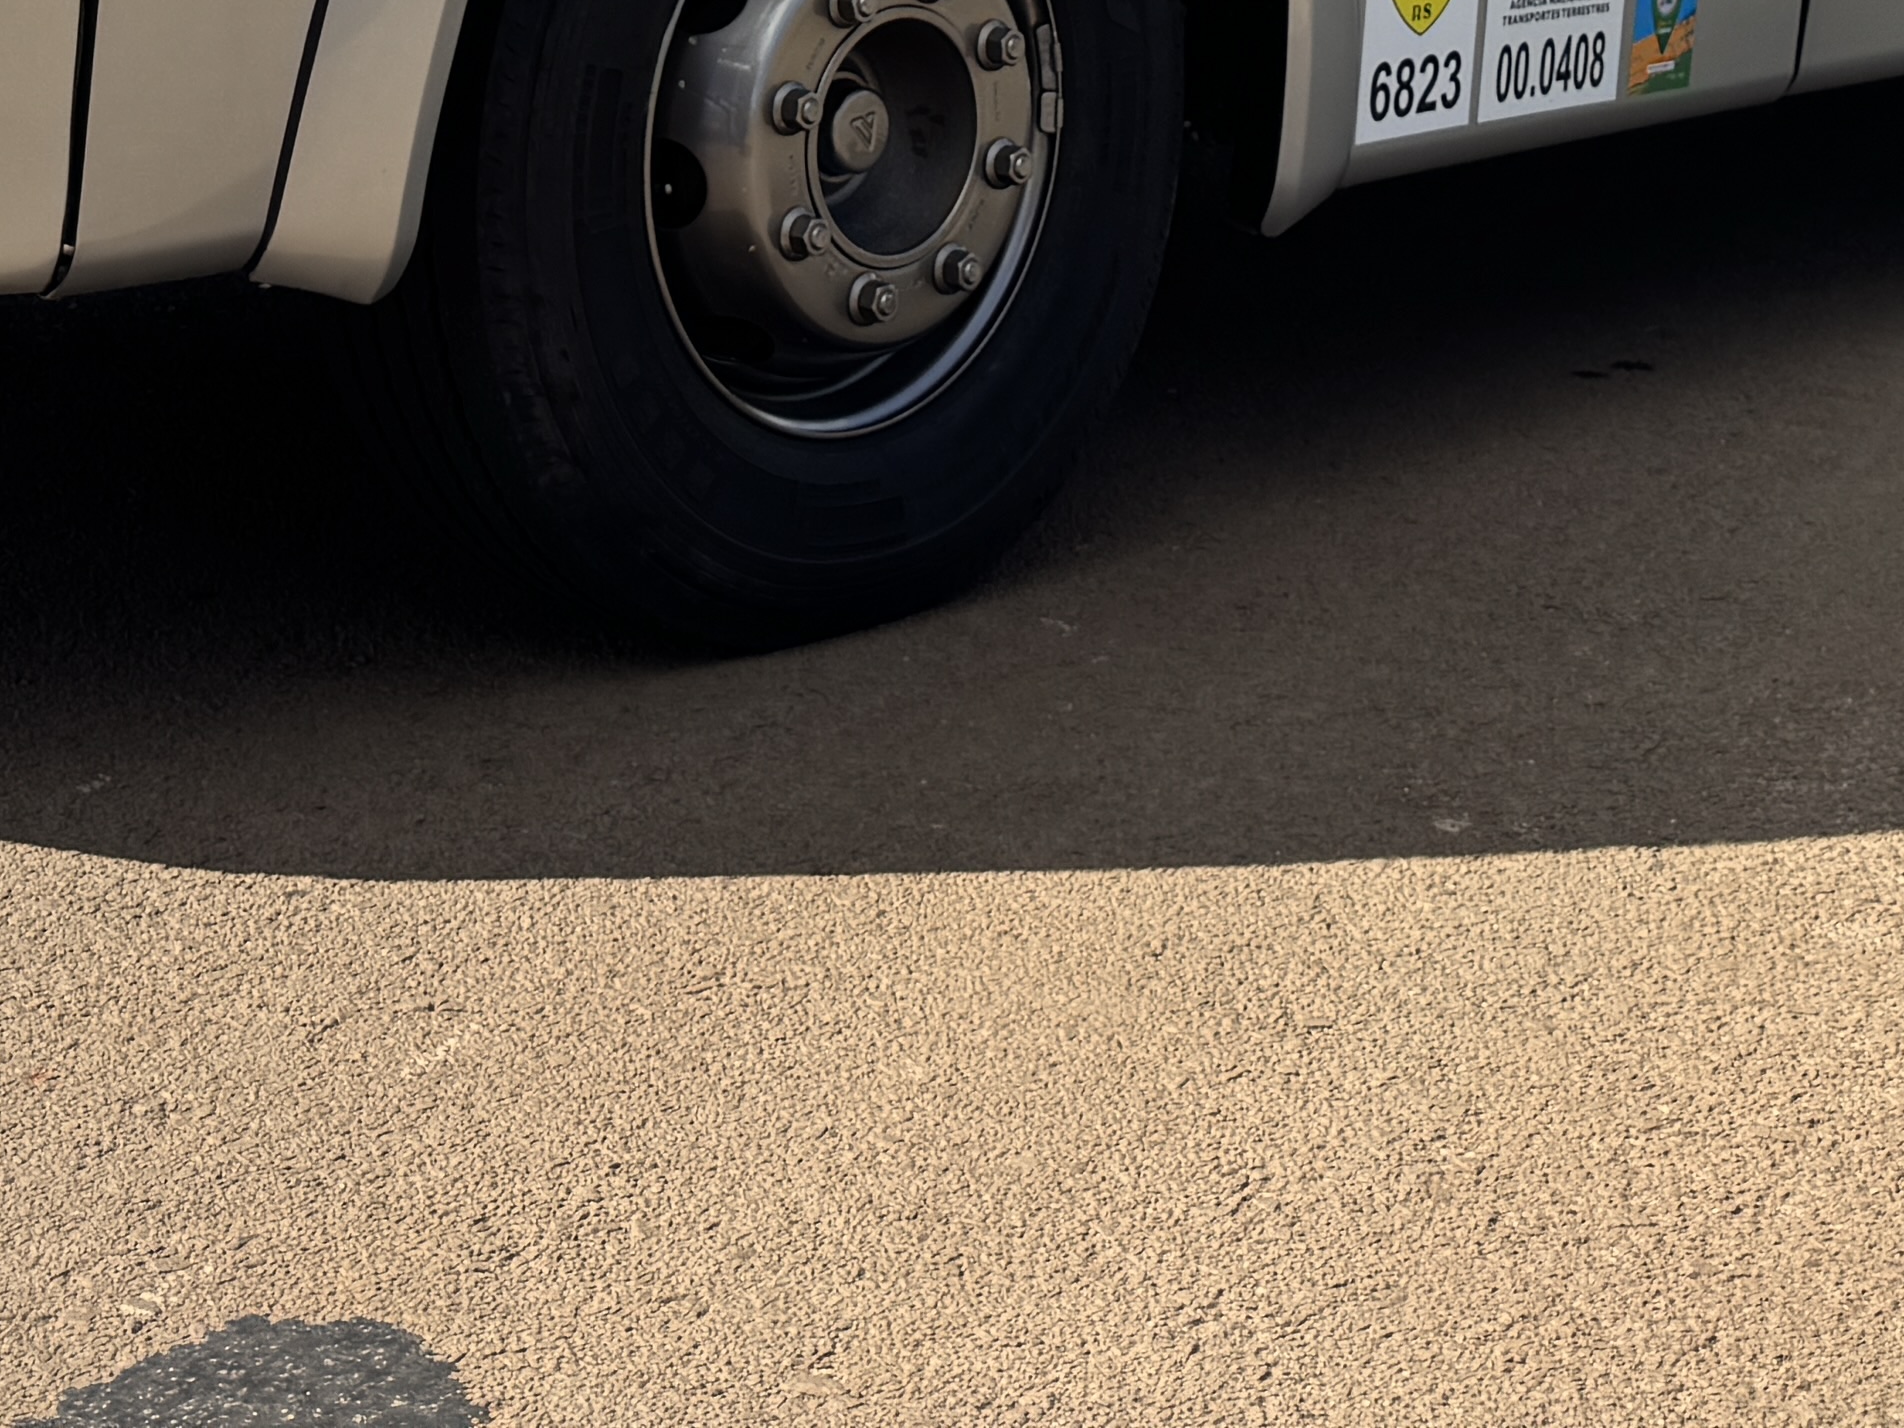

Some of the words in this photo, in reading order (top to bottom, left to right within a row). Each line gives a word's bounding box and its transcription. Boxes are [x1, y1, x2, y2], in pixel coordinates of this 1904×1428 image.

[1411, 2, 1433, 22] RS
[1502, 8, 1561, 27] TRANSPORTES
[1562, 2, 1611, 19] TERRESTRES
[1369, 50, 1462, 123] 6823
[1495, 30, 1606, 104] 00.0408
